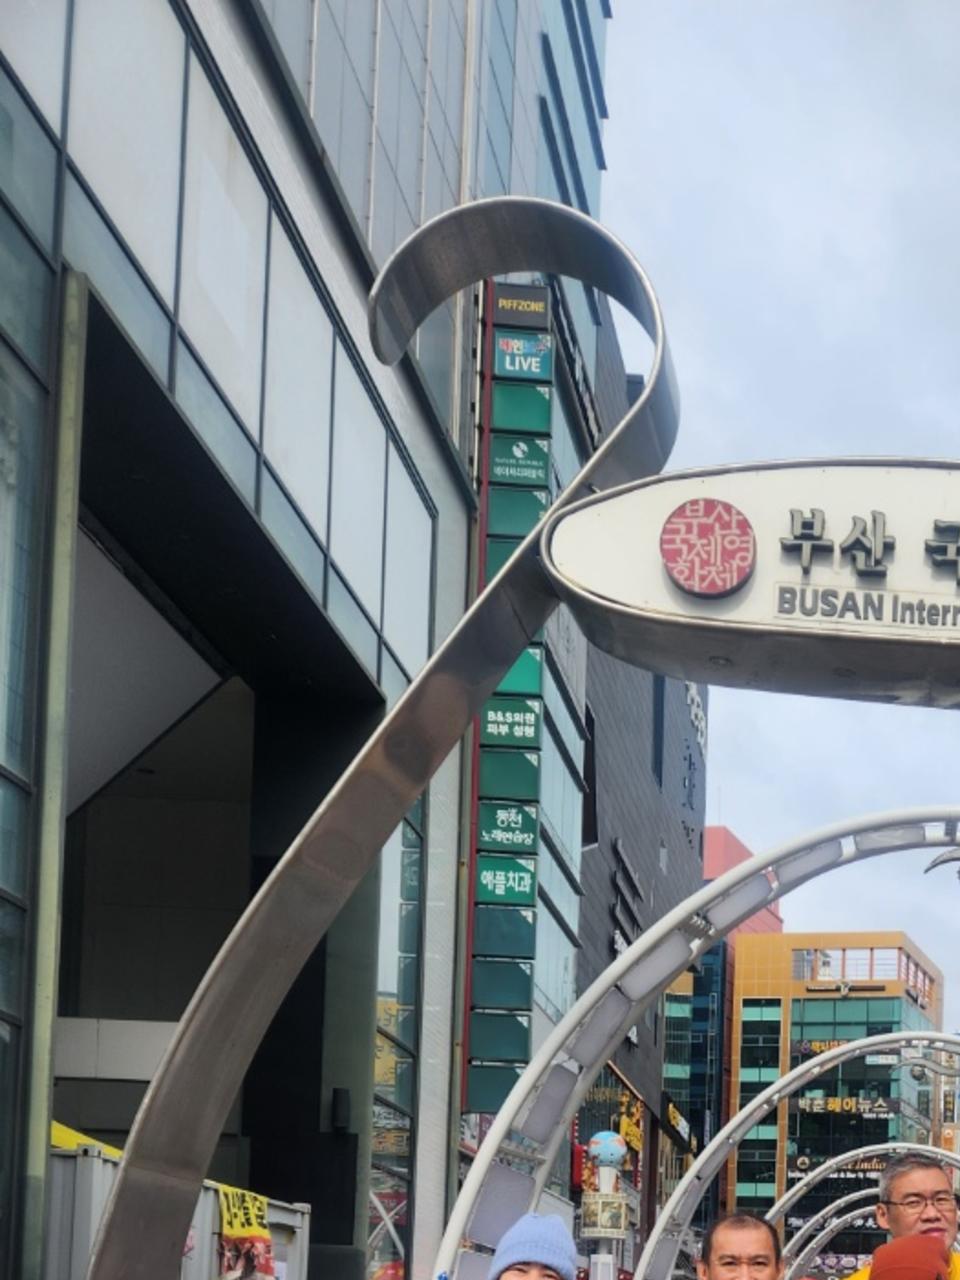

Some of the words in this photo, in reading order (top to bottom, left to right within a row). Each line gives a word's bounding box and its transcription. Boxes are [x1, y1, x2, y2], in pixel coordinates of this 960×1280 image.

[498, 298, 546, 312] PIFFZONE
[505, 355, 541, 372] LIVE
[779, 508, 896, 577] 부산
[778, 586, 884, 621] BUSAN
[480, 829, 535, 846] 노래연습장
[480, 869, 532, 896] 애플치과
